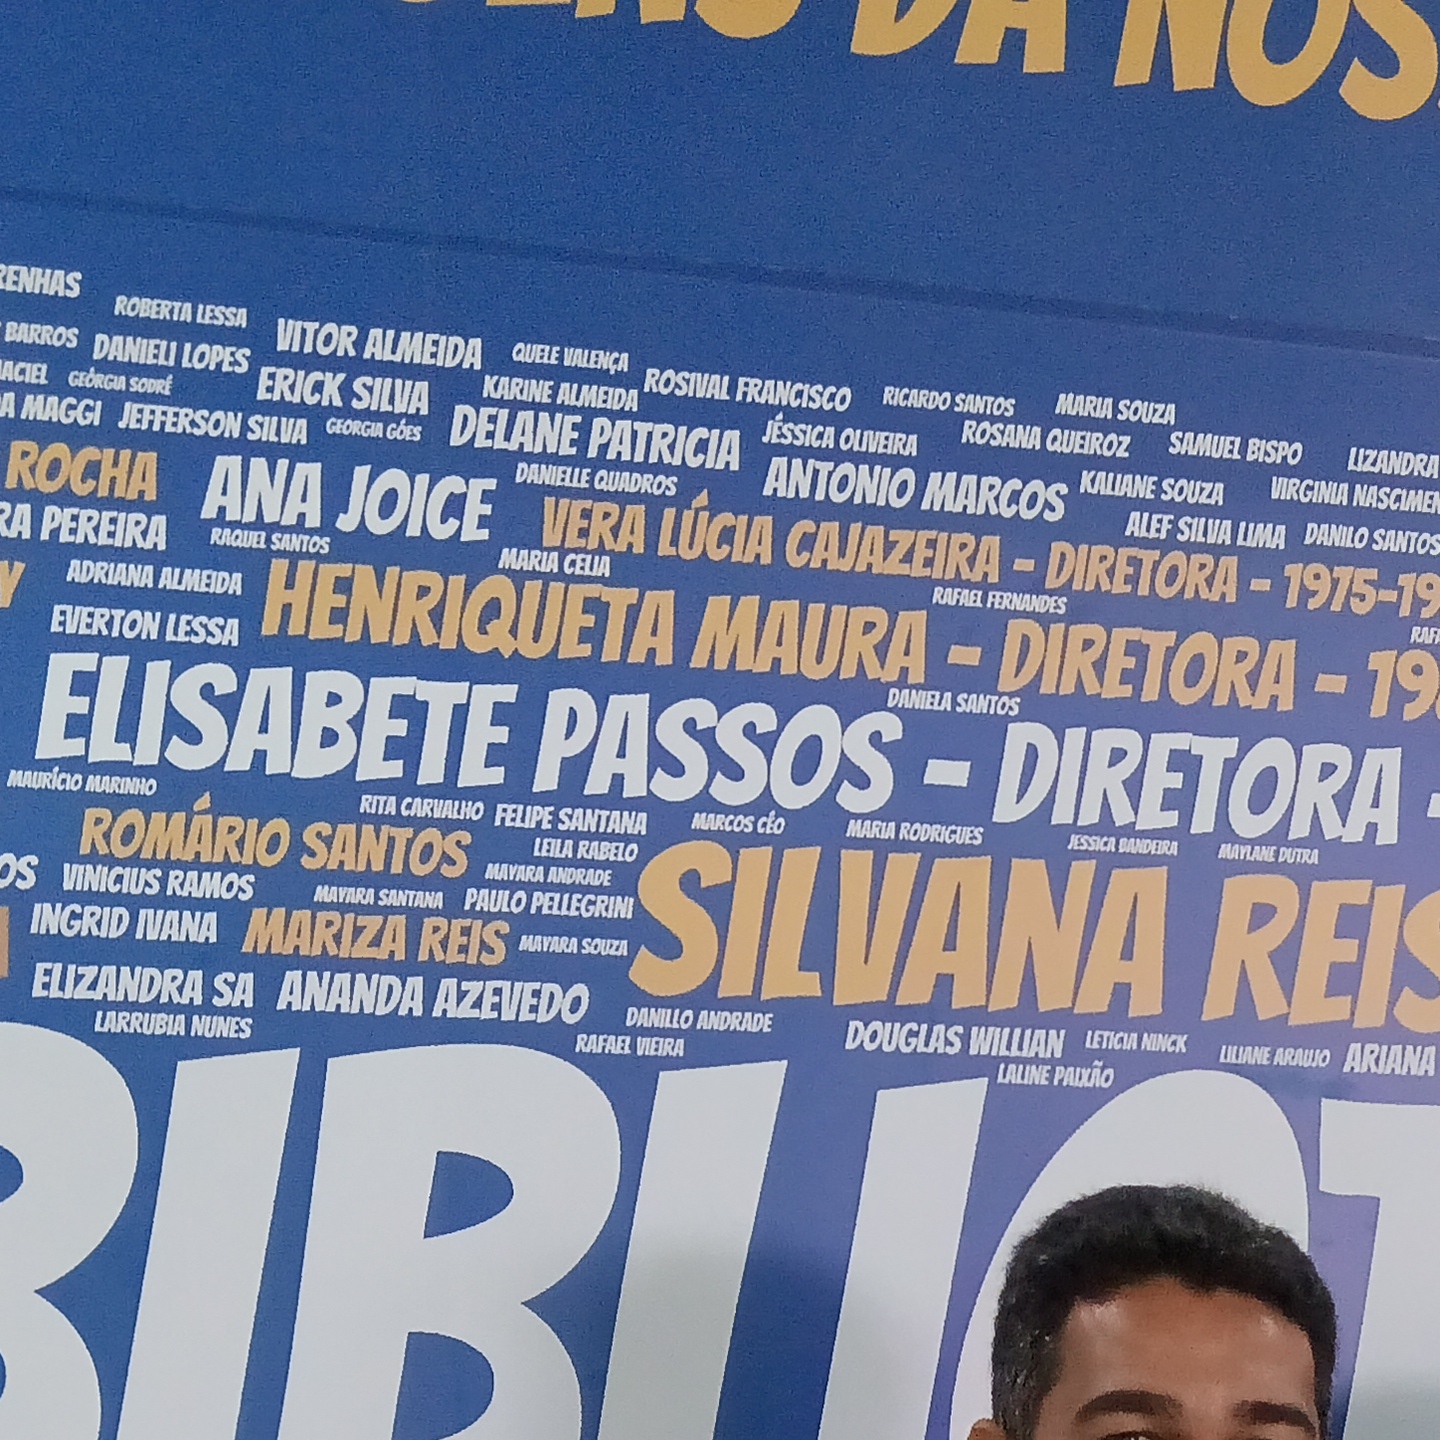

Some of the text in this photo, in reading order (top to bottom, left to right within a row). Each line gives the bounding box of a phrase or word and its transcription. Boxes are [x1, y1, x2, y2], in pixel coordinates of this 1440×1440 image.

[277, 318, 482, 370] VITOR ALMEIDA
[1055, 393, 1175, 425] MARIA SOUZA
[5, 441, 157, 501] ROCHA
[201, 456, 497, 541] ANA JOICE
[763, 457, 1068, 522] ANTONIO MARCOS
[543, 497, 645, 553] VERA
[658, 489, 772, 565] LÚCIA
[786, 520, 1000, 583] CAJAZEIRA
[1045, 542, 1238, 603] DIRETORA
[261, 558, 676, 666] HENRIQUETA
[690, 595, 927, 684] MAURA
[998, 616, 1297, 712] DIRETORA
[35, 651, 520, 790] ELISABETE
[532, 686, 902, 812] PASSOS
[992, 719, 1402, 848] DIRETORA
[79, 795, 471, 877] ROMÁRIO SANTOS
[242, 908, 509, 965] MARIZA REIS
[626, 838, 1170, 1017] SILVANA
[277, 970, 589, 1024] ANANDA AZEVEDO
